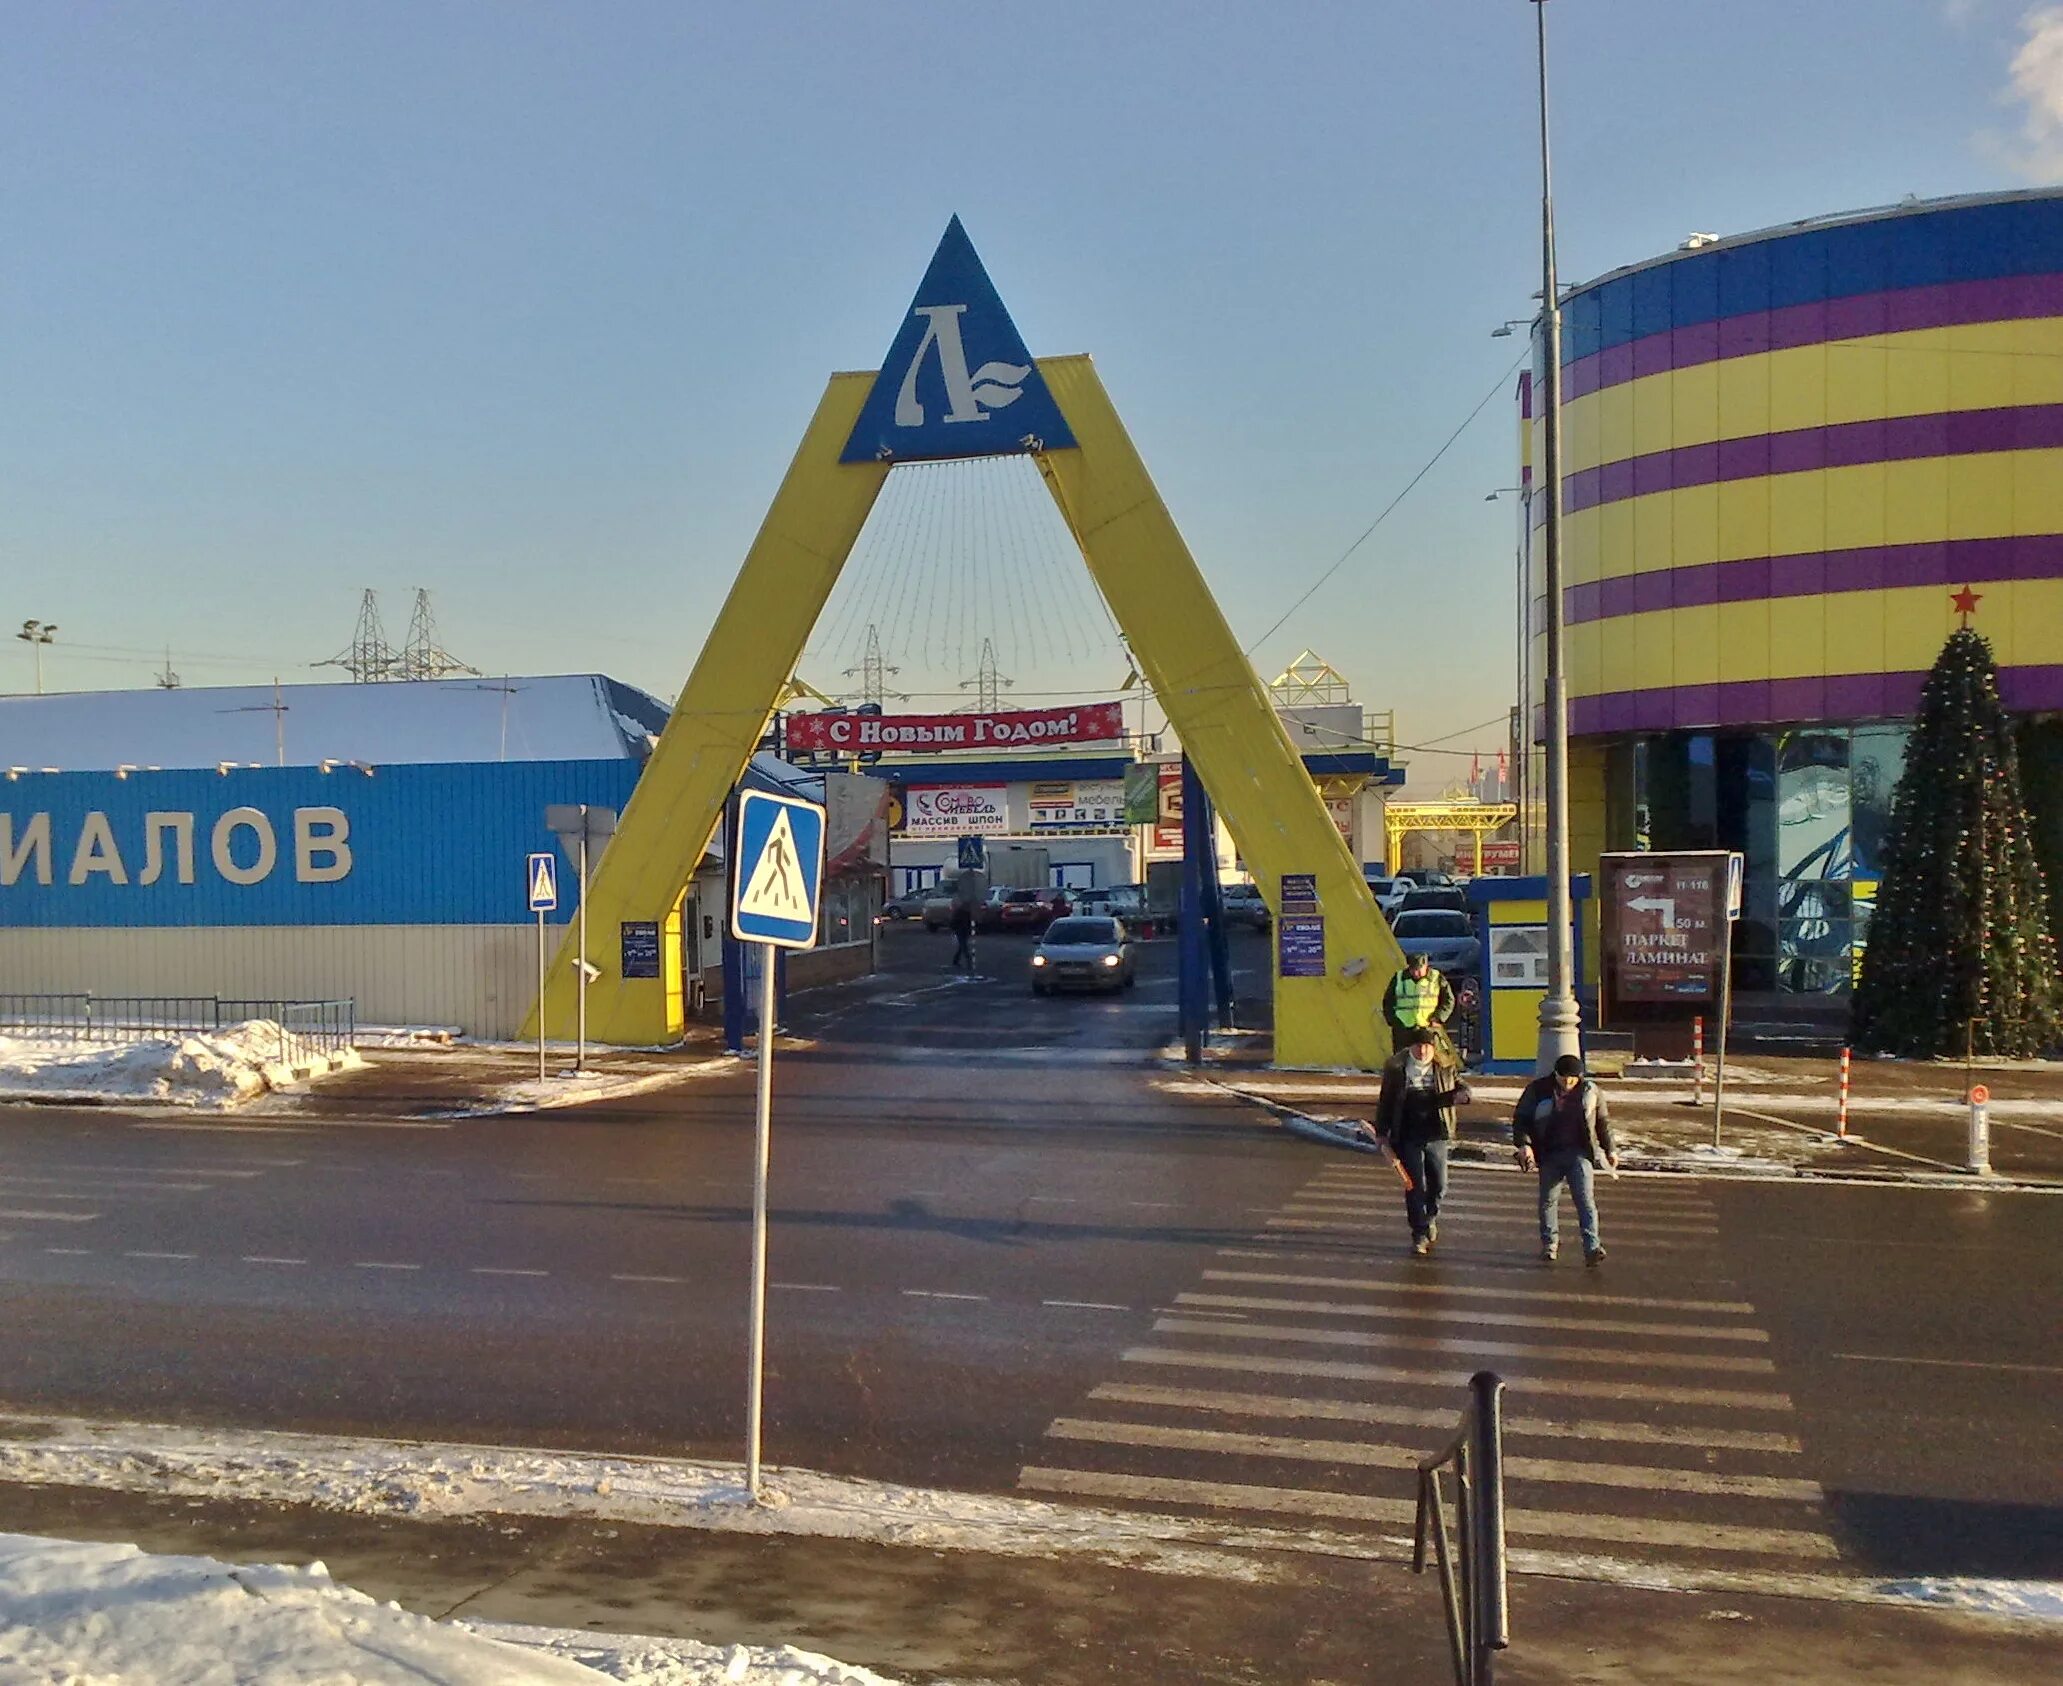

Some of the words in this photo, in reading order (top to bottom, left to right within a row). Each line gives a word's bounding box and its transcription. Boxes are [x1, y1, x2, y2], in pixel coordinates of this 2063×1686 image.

[830, 721, 851, 742] С
[859, 720, 966, 743] Новым
[973, 712, 1078, 742] Годом!
[912, 816, 959, 826] МАССИВ
[968, 815, 1004, 825] ШПОН
[0, 806, 353, 886] ИАЛОВ
[1676, 917, 1692, 929] 50
[1624, 933, 1689, 946] ПАРКЕТ
[1626, 951, 1708, 965] ЛАМИНАТ
